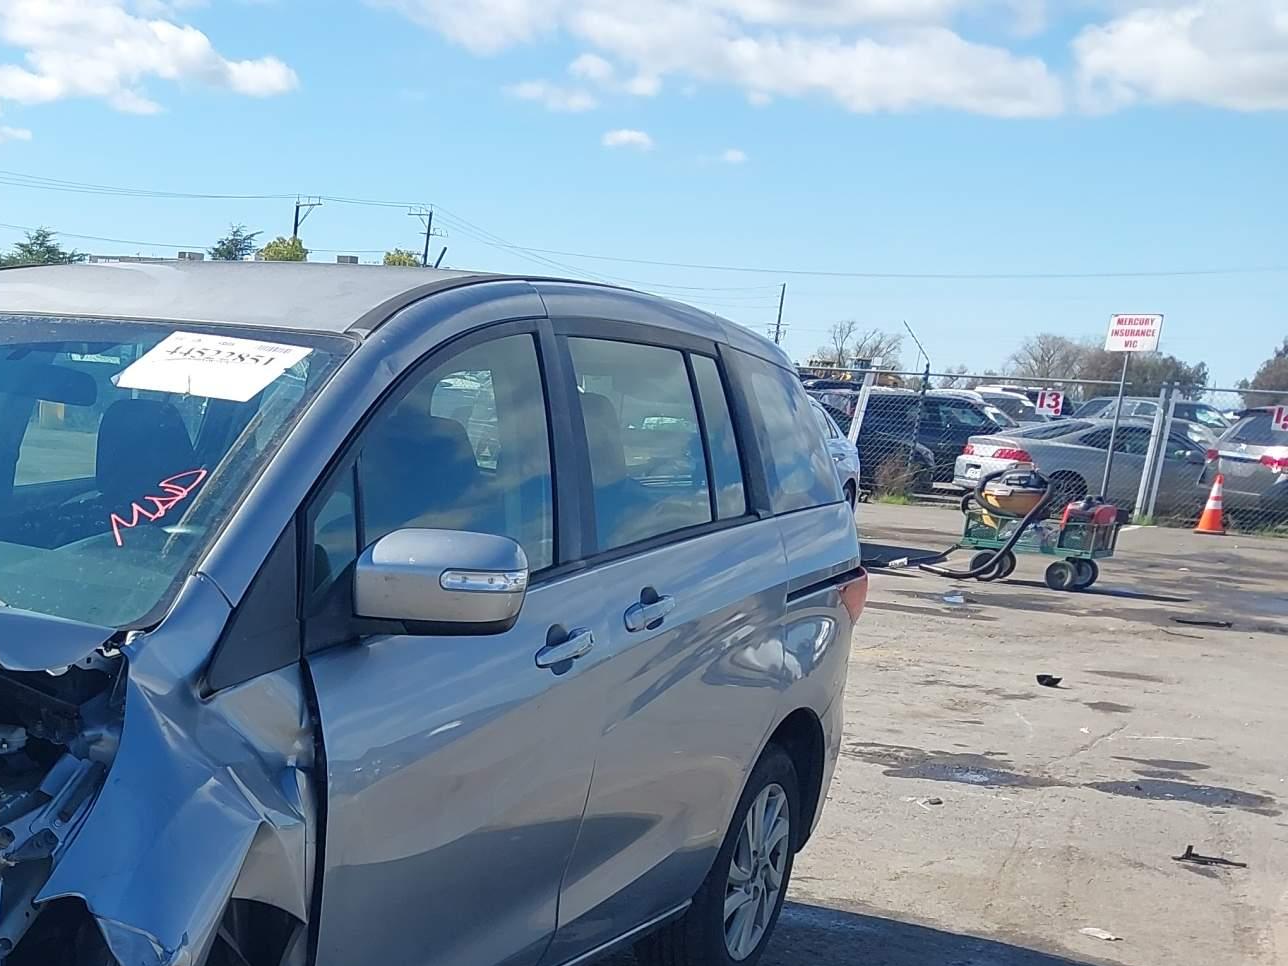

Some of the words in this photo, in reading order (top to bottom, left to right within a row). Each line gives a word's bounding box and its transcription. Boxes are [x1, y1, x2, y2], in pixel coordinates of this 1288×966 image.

[1117, 317, 1156, 326] MERCURY
[1111, 328, 1157, 337] INSURANCE
[165, 345, 276, 366] 44522851
[1274, 406, 1288, 424] 1
